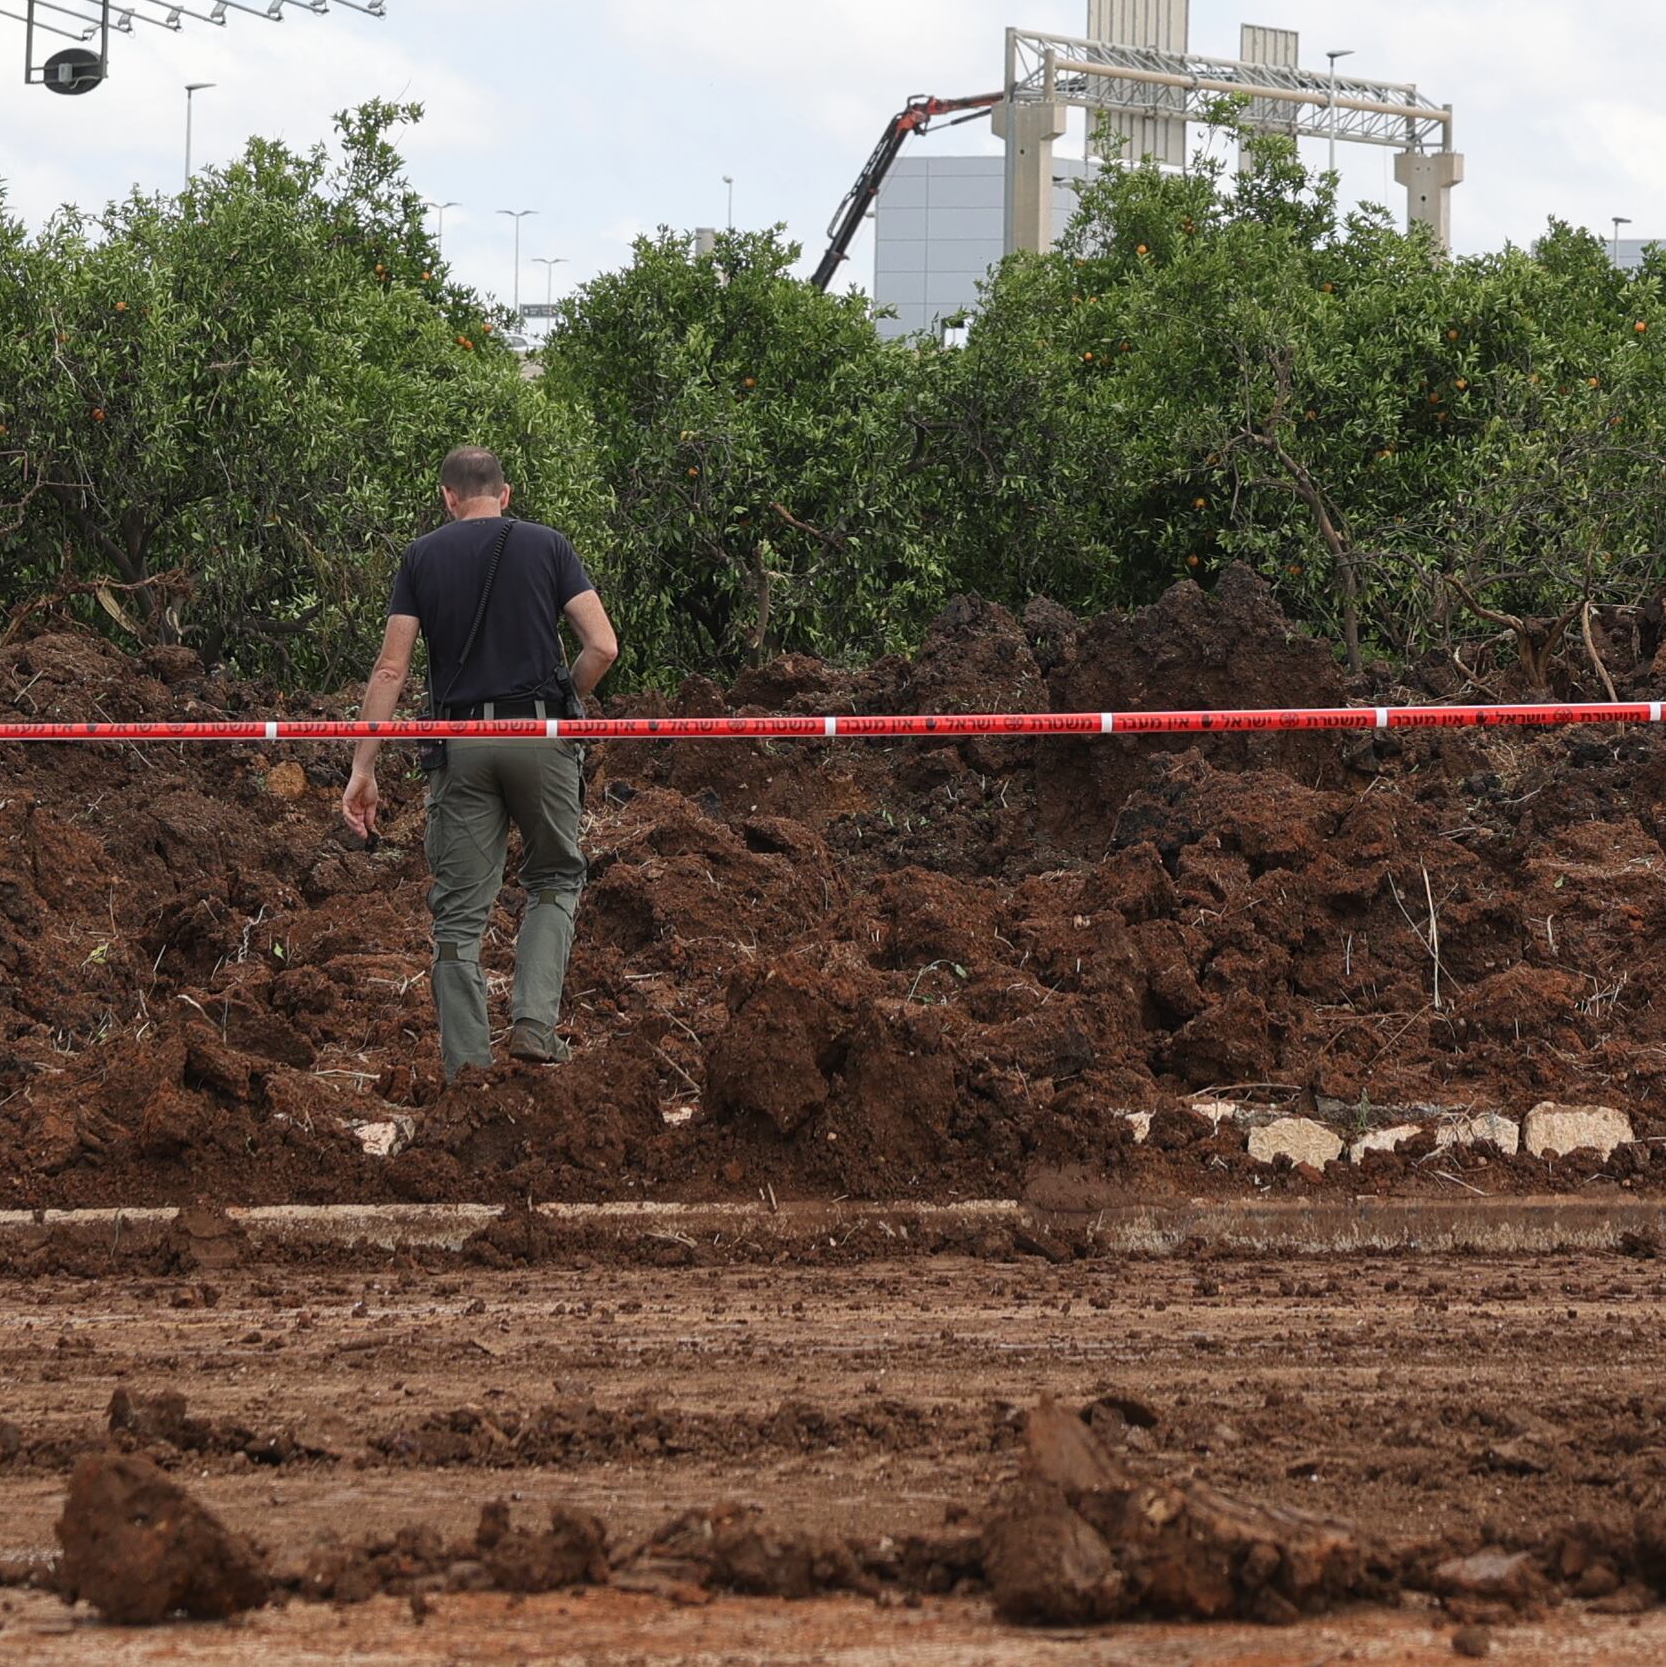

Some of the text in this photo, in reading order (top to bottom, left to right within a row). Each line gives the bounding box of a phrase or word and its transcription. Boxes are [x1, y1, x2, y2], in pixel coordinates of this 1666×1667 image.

[1118, 715, 1367, 730] משטרת ישראל אין מעבר
[1393, 715, 1436, 725] מעבר
[1496, 711, 1545, 724] ישראל
[1581, 712, 1641, 722] משטרת
[567, 720, 816, 735] משטרת ישראל אין מעבר
[842, 718, 1092, 733] משטרת ישראל אין מעבר
